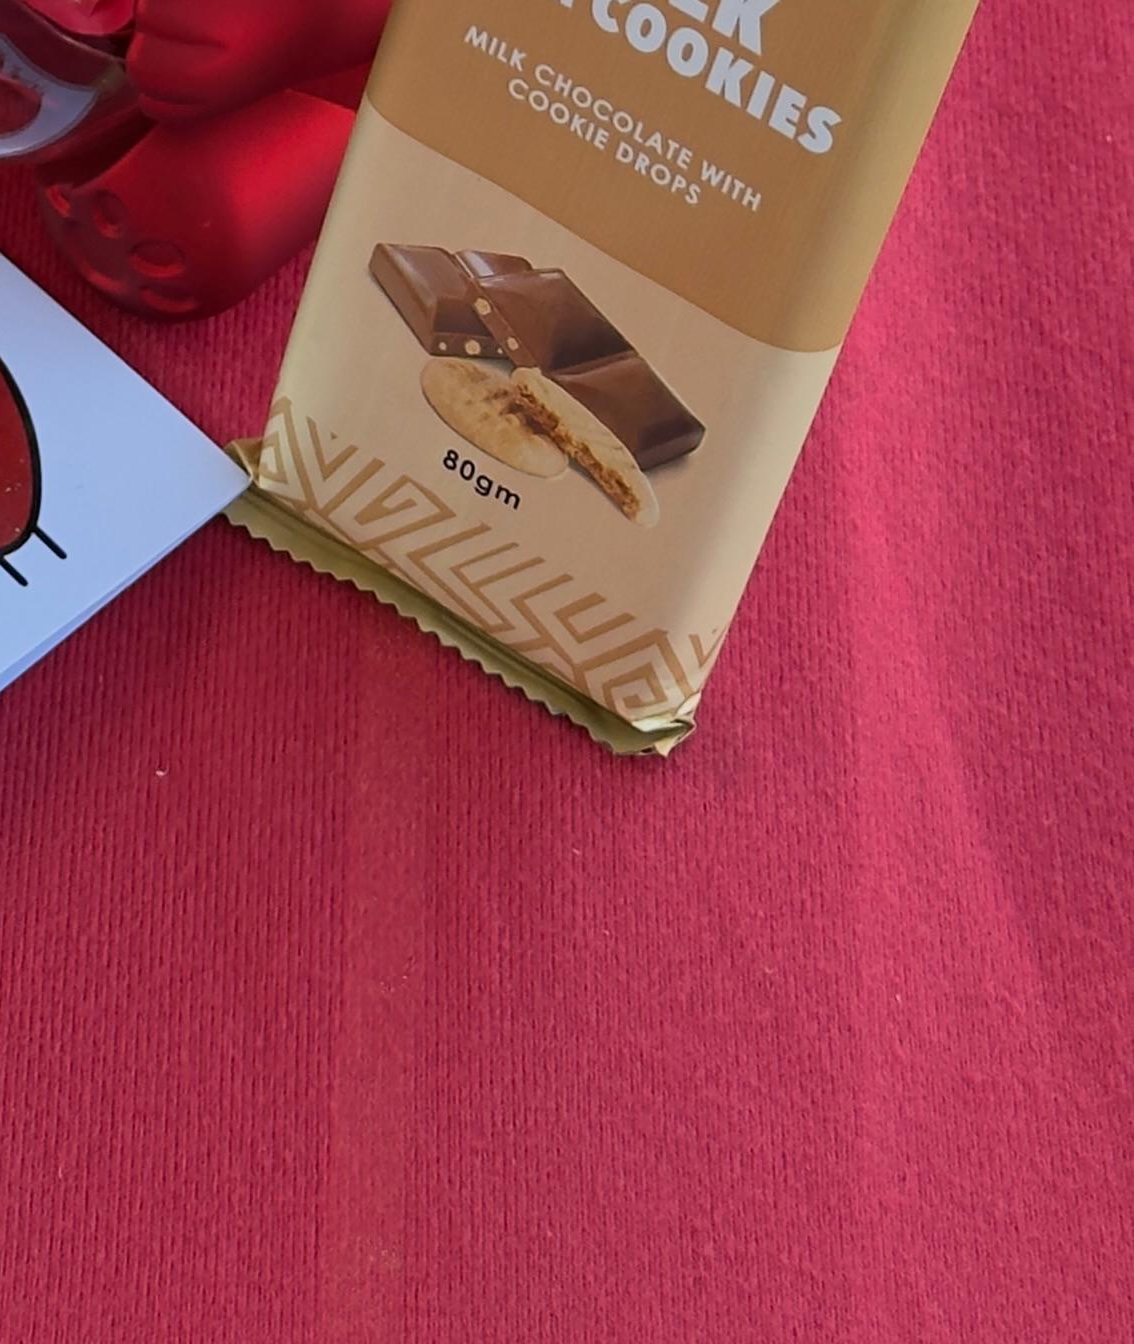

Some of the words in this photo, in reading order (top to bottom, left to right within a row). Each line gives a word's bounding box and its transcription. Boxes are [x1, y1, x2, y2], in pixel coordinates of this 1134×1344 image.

[464, 25, 527, 72] MILK
[535, 64, 694, 170] CHOCOLATE
[701, 159, 762, 211] WITH
[508, 77, 609, 150] COOKIE
[616, 142, 702, 205] DROPS
[443, 449, 521, 510] 80gm
